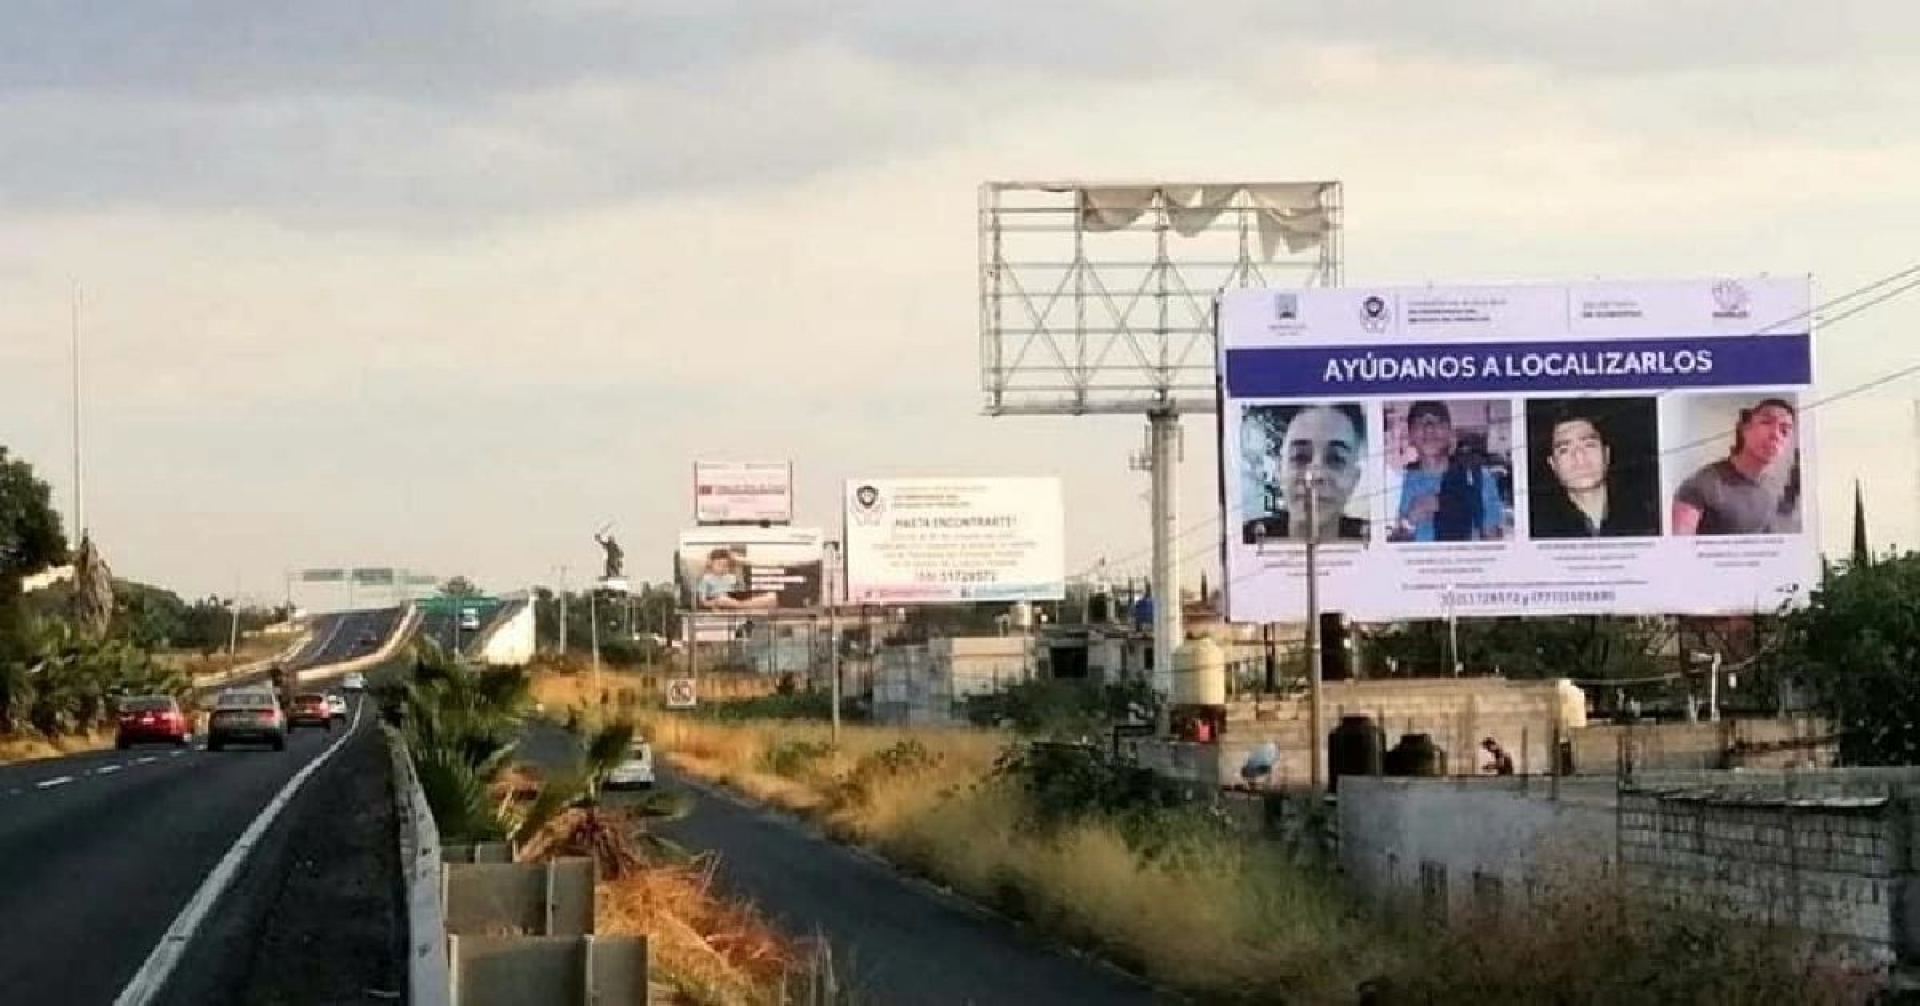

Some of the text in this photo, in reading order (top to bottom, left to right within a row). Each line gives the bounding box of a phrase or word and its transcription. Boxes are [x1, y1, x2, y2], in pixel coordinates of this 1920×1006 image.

[1323, 349, 1713, 382] AYÚDANOS A LOCALIZARLOS
